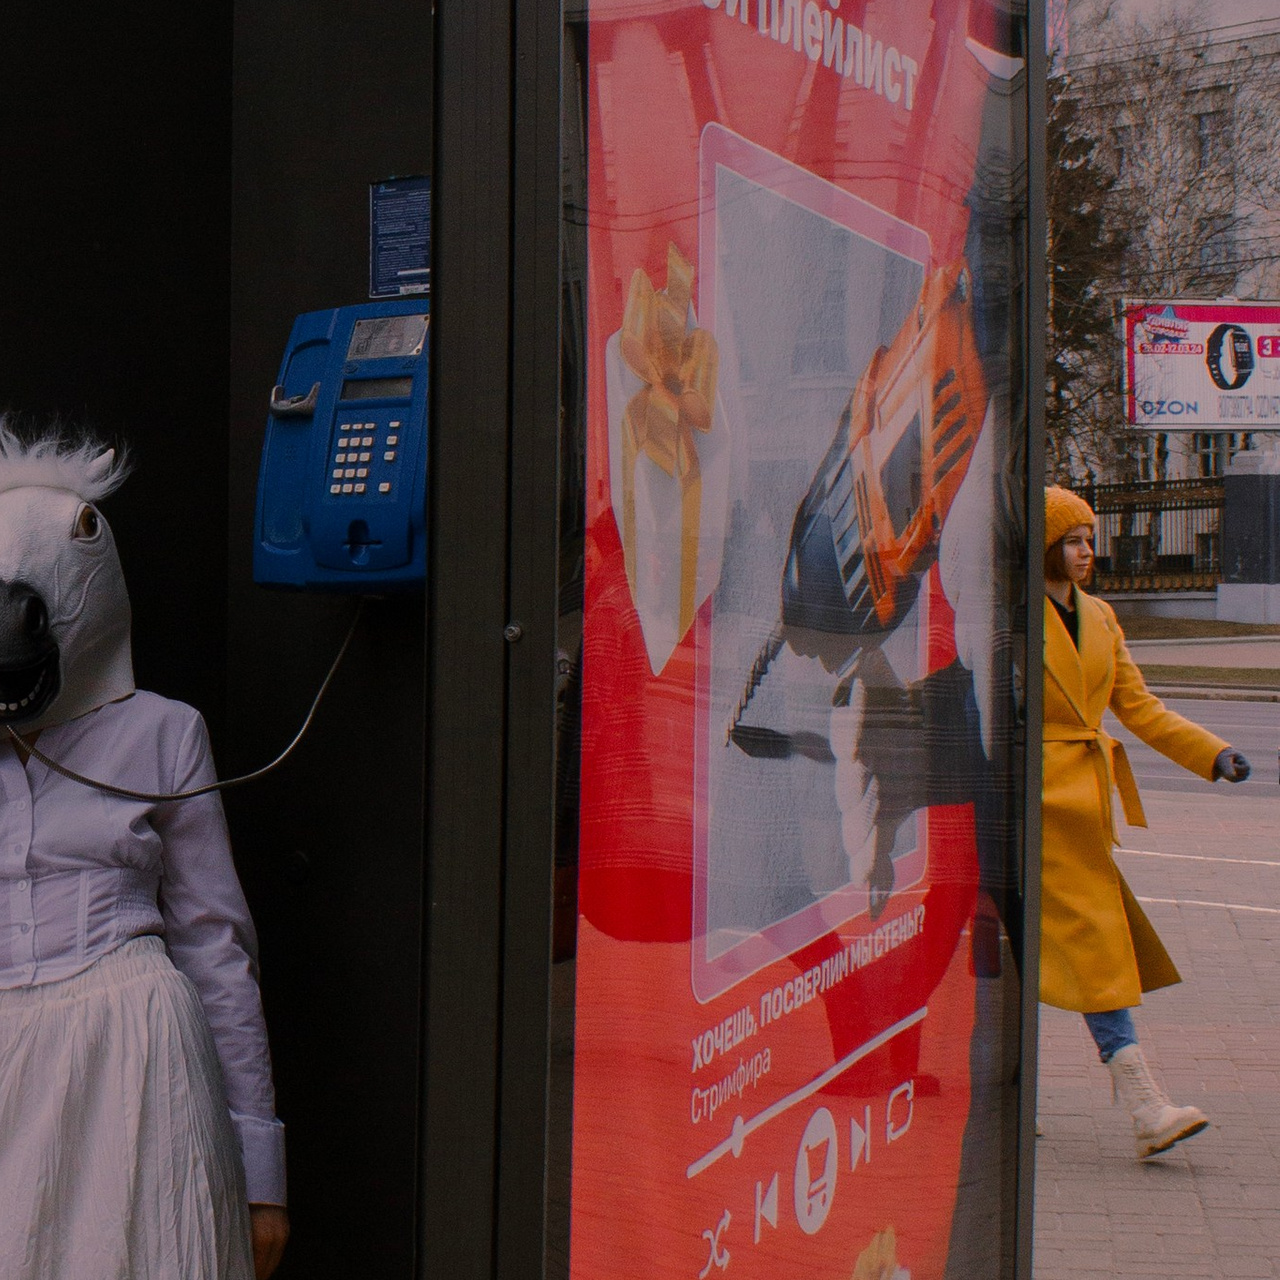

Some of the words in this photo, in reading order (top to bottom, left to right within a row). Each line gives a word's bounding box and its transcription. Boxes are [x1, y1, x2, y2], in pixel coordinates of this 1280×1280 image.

[1142, 401, 1198, 415] OZON
[691, 1006, 759, 1073] ХОЧЕШЬ,
[760, 948, 850, 1028] ПОСВЕРЛИМ
[851, 938, 873, 973] МЫ
[874, 904, 926, 958] СТЕНЫ?
[691, 1046, 772, 1125] Стримфира
